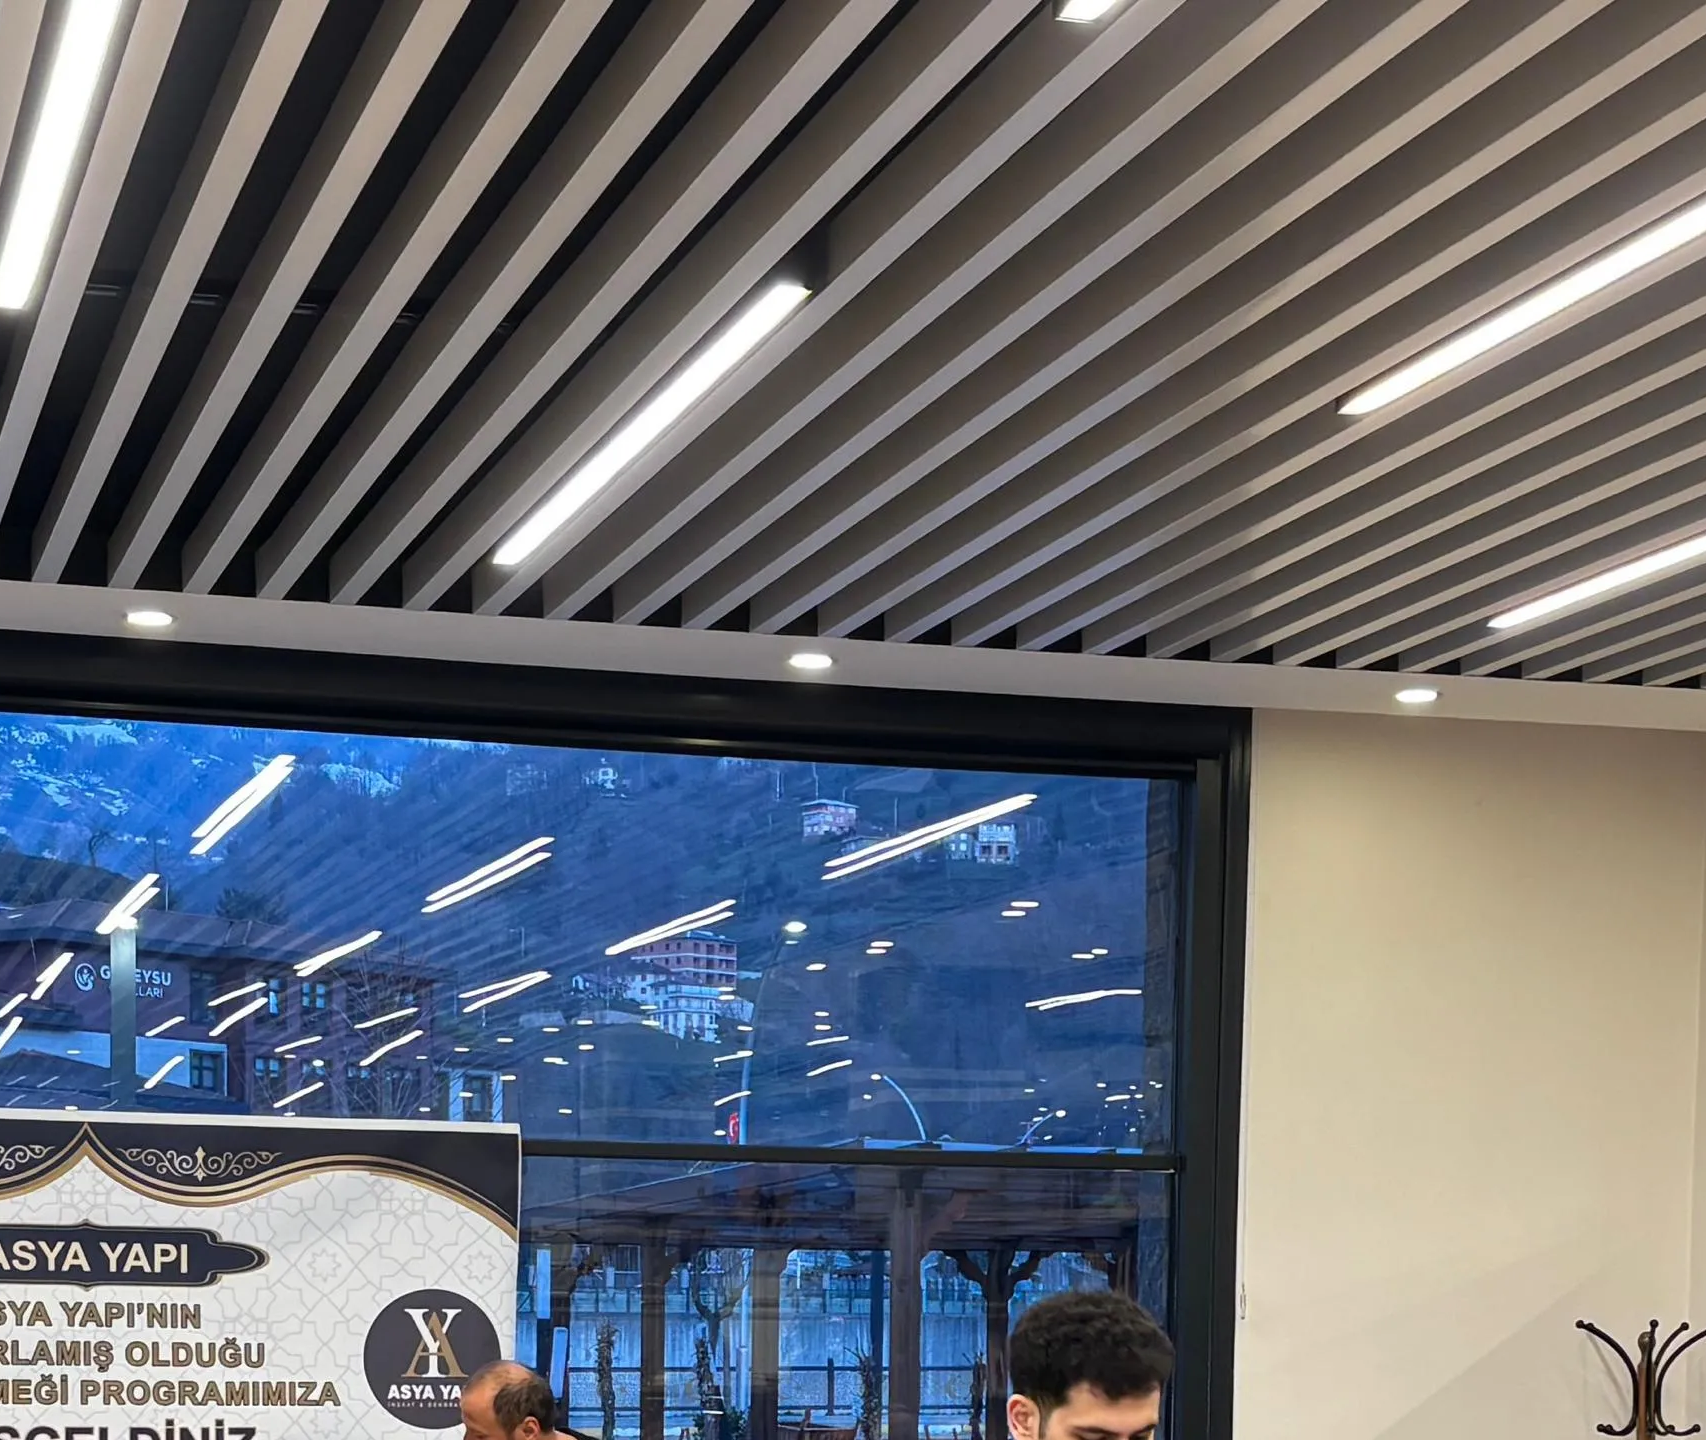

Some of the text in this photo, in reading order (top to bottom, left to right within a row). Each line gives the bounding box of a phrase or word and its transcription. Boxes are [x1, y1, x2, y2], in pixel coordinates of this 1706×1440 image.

[99, 964, 172, 987] GEYSU
[99, 1241, 188, 1274] YAPI
[125, 1337, 265, 1368] OLDUĞU
[80, 1379, 342, 1407] PROGRAMIMIZA
[387, 1384, 461, 1400] ASYA YA
